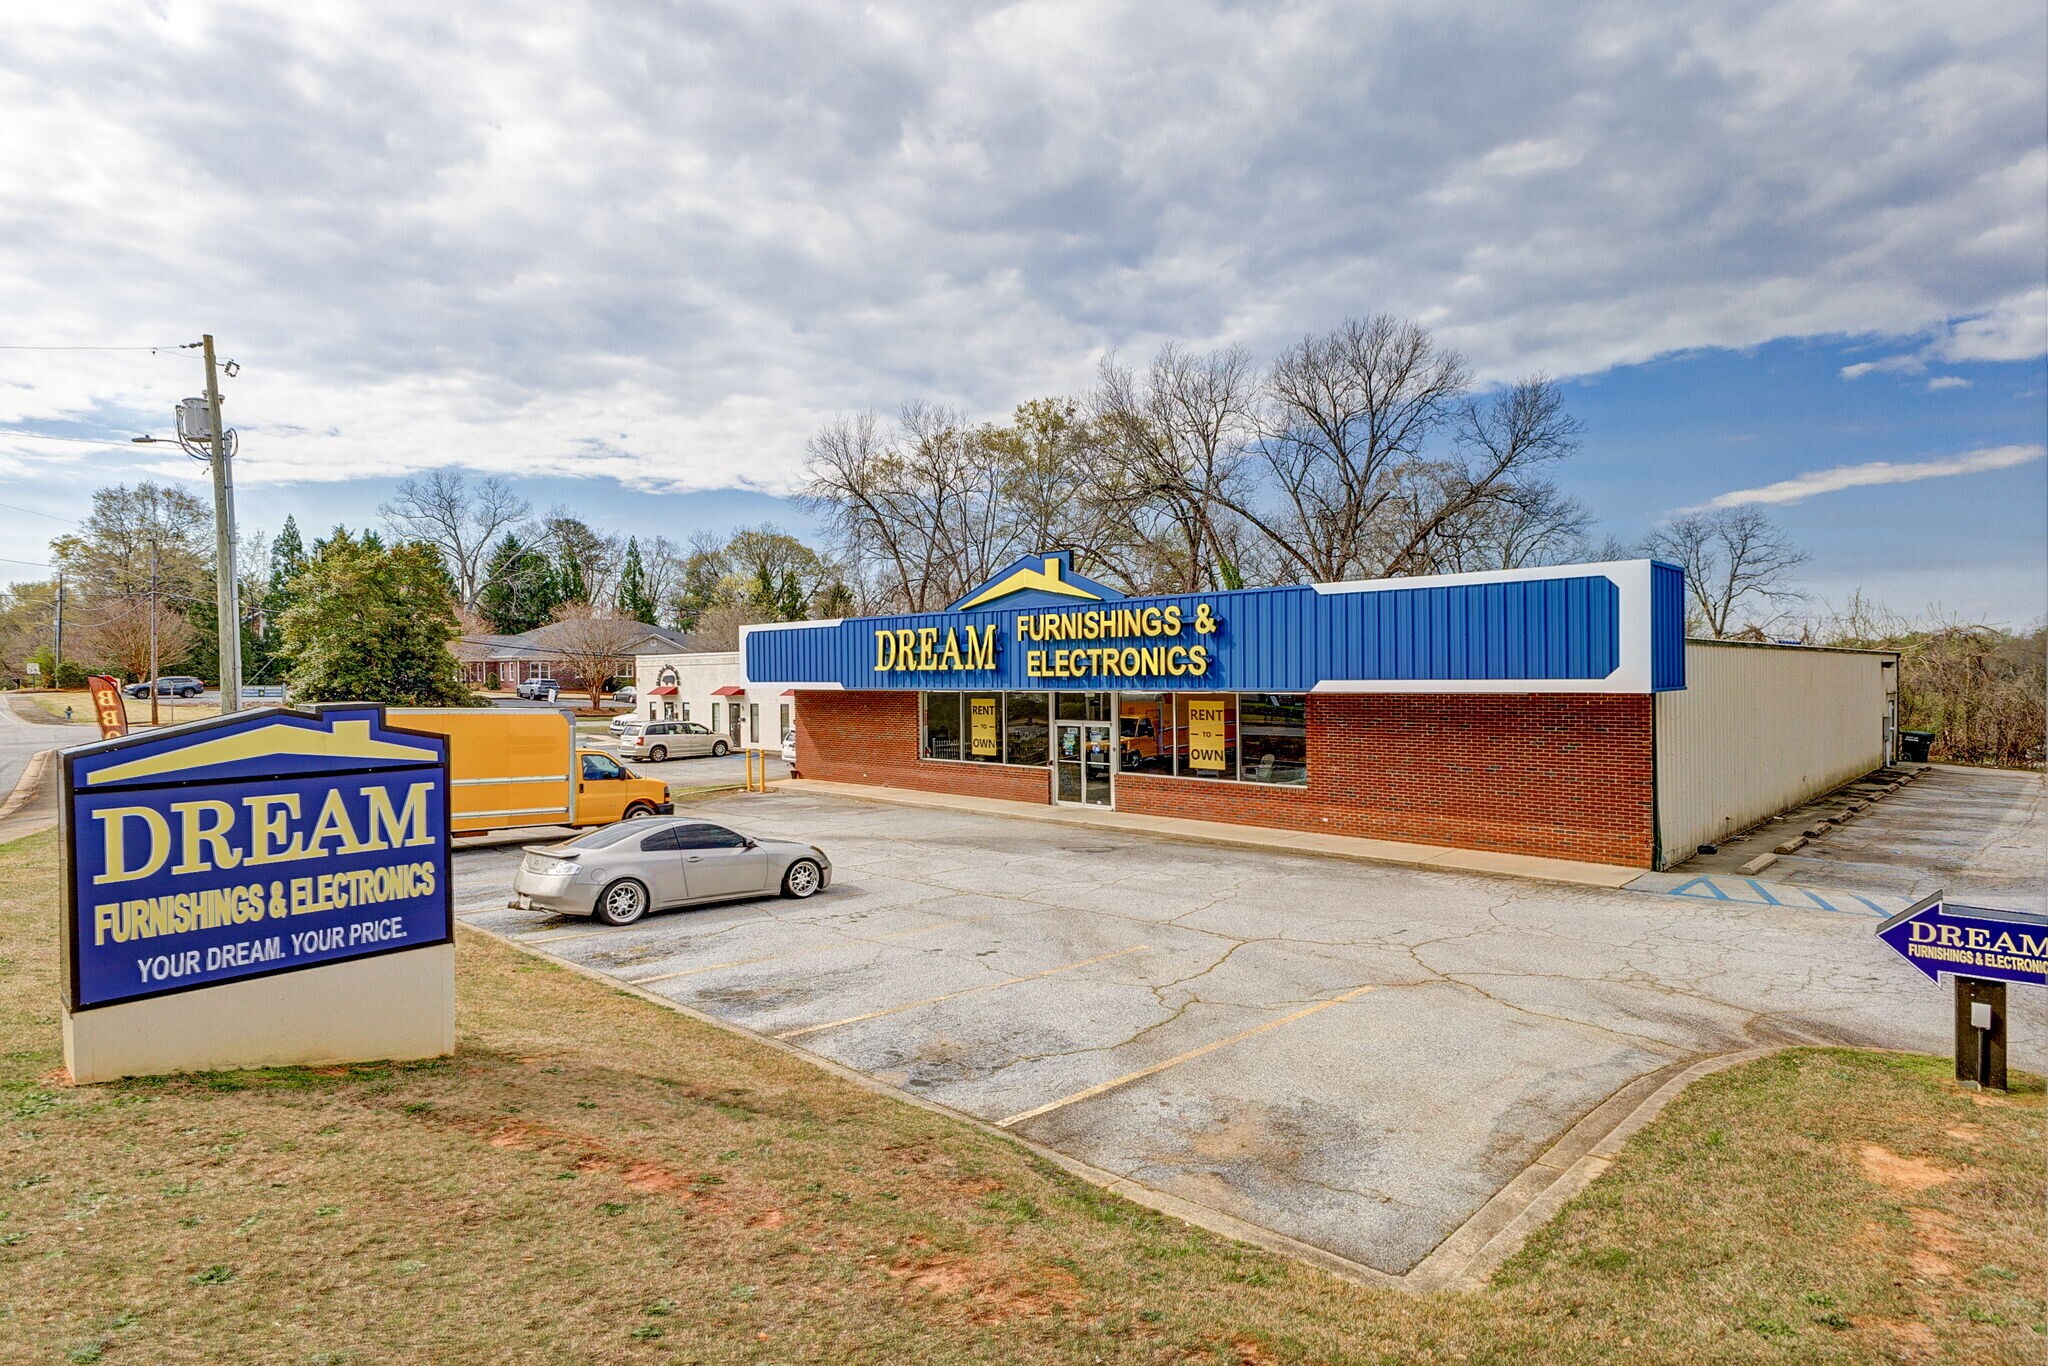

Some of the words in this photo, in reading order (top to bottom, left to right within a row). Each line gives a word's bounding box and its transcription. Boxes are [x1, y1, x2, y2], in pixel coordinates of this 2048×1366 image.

[1016, 605, 1182, 642] FURNISHINGS
[1196, 603, 1218, 635] &
[873, 623, 997, 672] DREAM
[1026, 645, 1209, 678] ELECTRONICS
[972, 705, 995, 716] RENT
[1190, 709, 1223, 721] RENT
[972, 738, 995, 749] OWN
[1191, 748, 1224, 762] OWN
[92, 781, 436, 886] DREAM
[94, 884, 265, 946] FURNISHINGS
[268, 880, 288, 919] &
[290, 861, 436, 916] ELECTRONICS
[137, 950, 202, 983] YOUR
[206, 936, 286, 972] DREAM.
[291, 926, 346, 956] YOUR
[348, 916, 408, 948] PRICE.
[1908, 920, 2048, 958] DREAM
[1908, 942, 1974, 965] FURNISHINGS
[1975, 952, 1984, 966] &
[1984, 953, 2048, 975] ELECTRONIC
